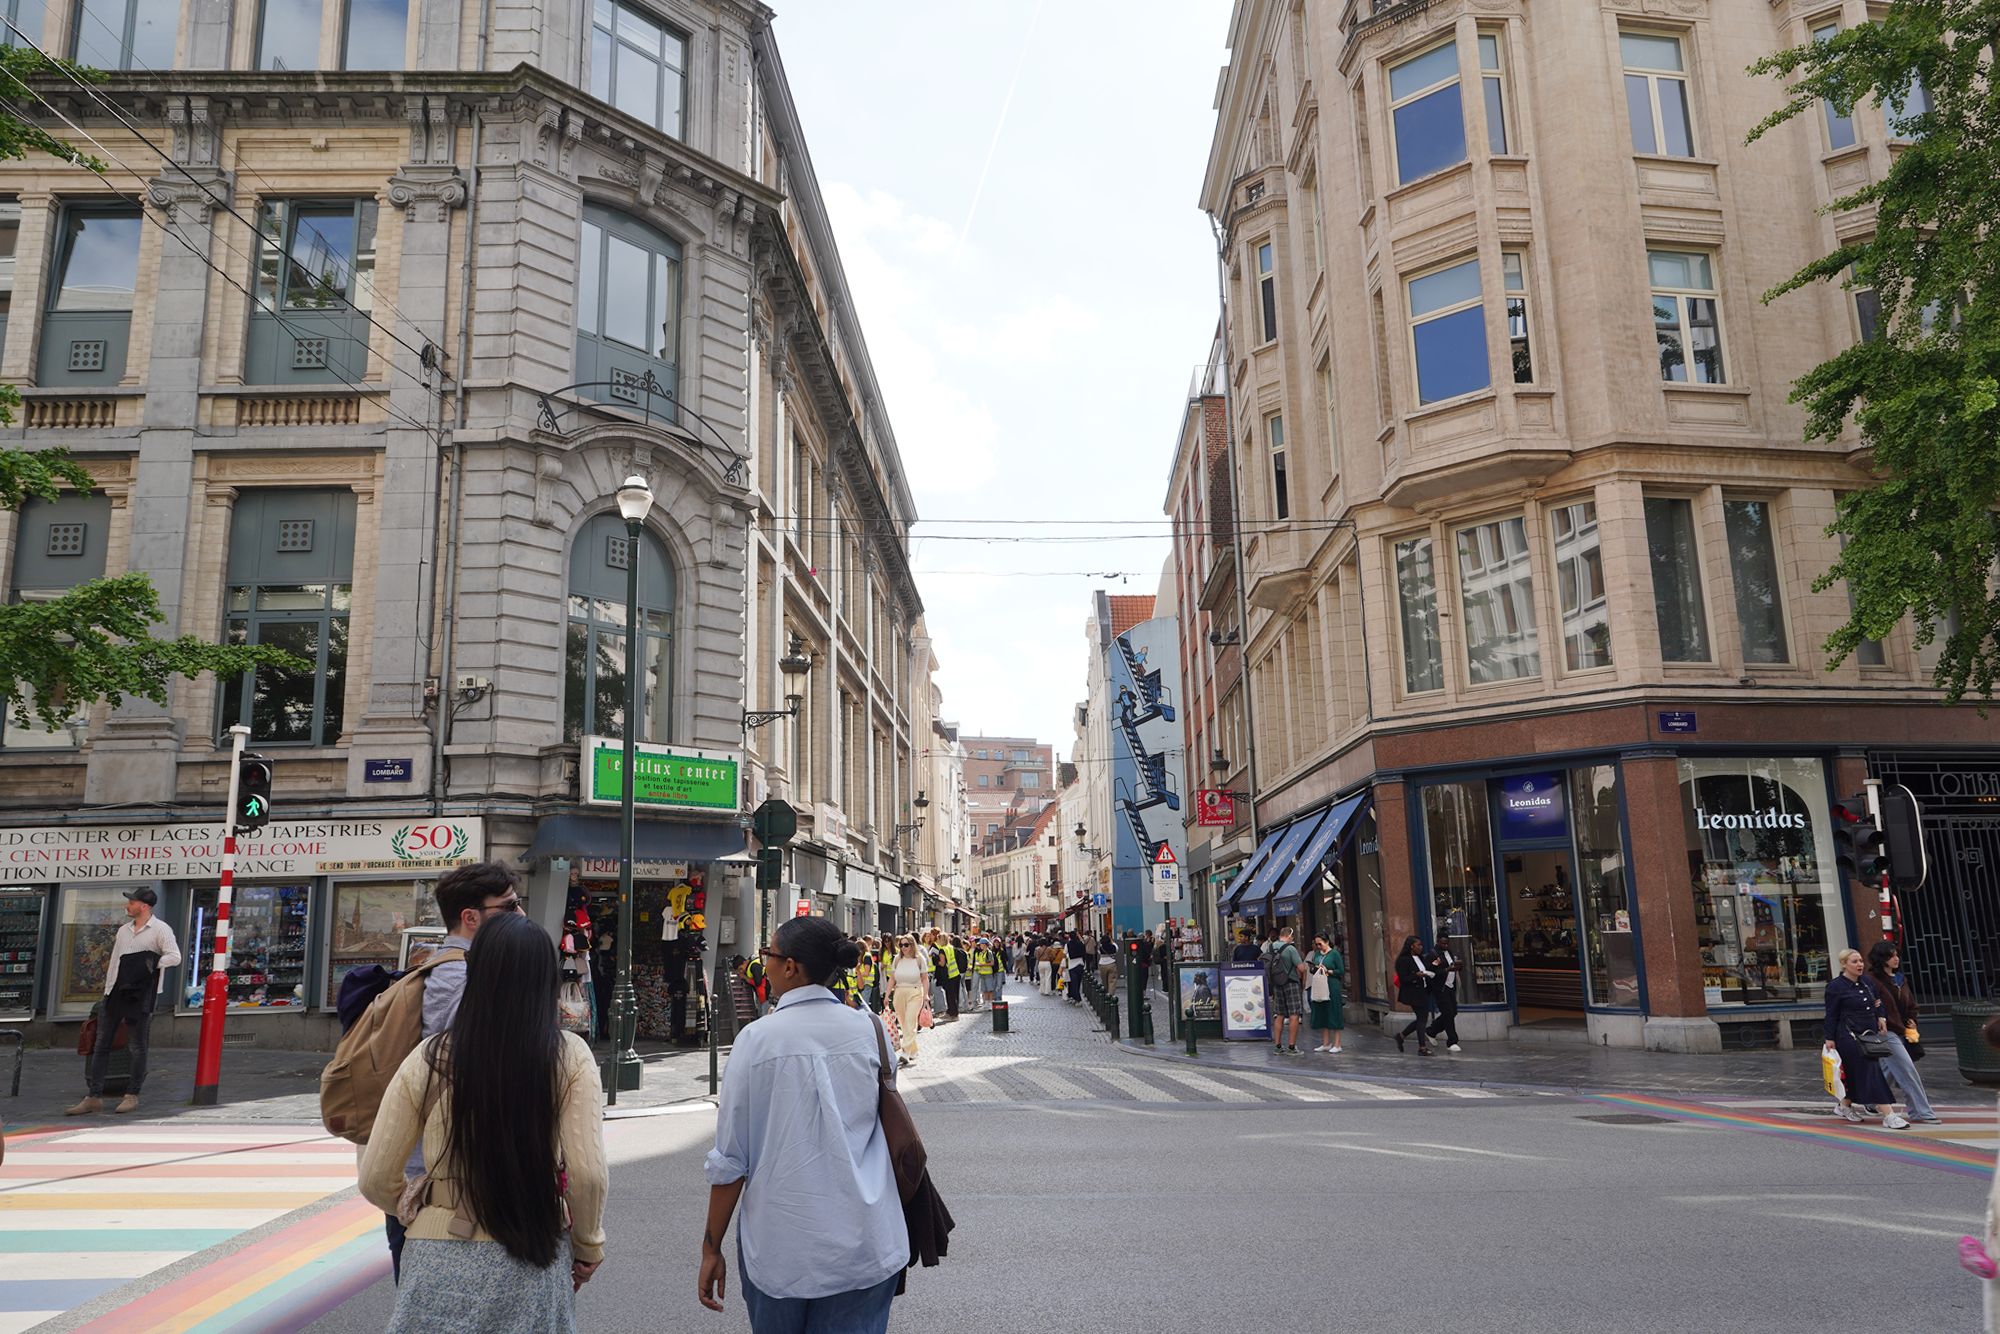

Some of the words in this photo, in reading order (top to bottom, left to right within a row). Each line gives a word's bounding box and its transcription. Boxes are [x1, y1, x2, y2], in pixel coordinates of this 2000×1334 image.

[372, 768, 404, 776] LOMBARD
[607, 758, 671, 775] tetilux
[1509, 796, 1552, 808] Leonidas
[1696, 806, 1806, 830] Leonidas
[30, 830, 110, 845] CENTER
[118, 829, 142, 842] OF
[151, 828, 210, 842] LACES
[270, 823, 382, 839] TAPESTRIES
[408, 825, 453, 850] 50
[10, 848, 89, 863] CENTER
[101, 846, 172, 860] WISHES
[180, 844, 219, 858] YOU
[56, 864, 120, 878] INSIDE
[129, 862, 178, 876] FREE
[329, 862, 344, 870] SEND
[347, 861, 361, 869] YOUR
[363, 861, 395, 869] PURCHASES
[398, 859, 432, 868] EVERYWHERE
[434, 859, 440, 867] IN
